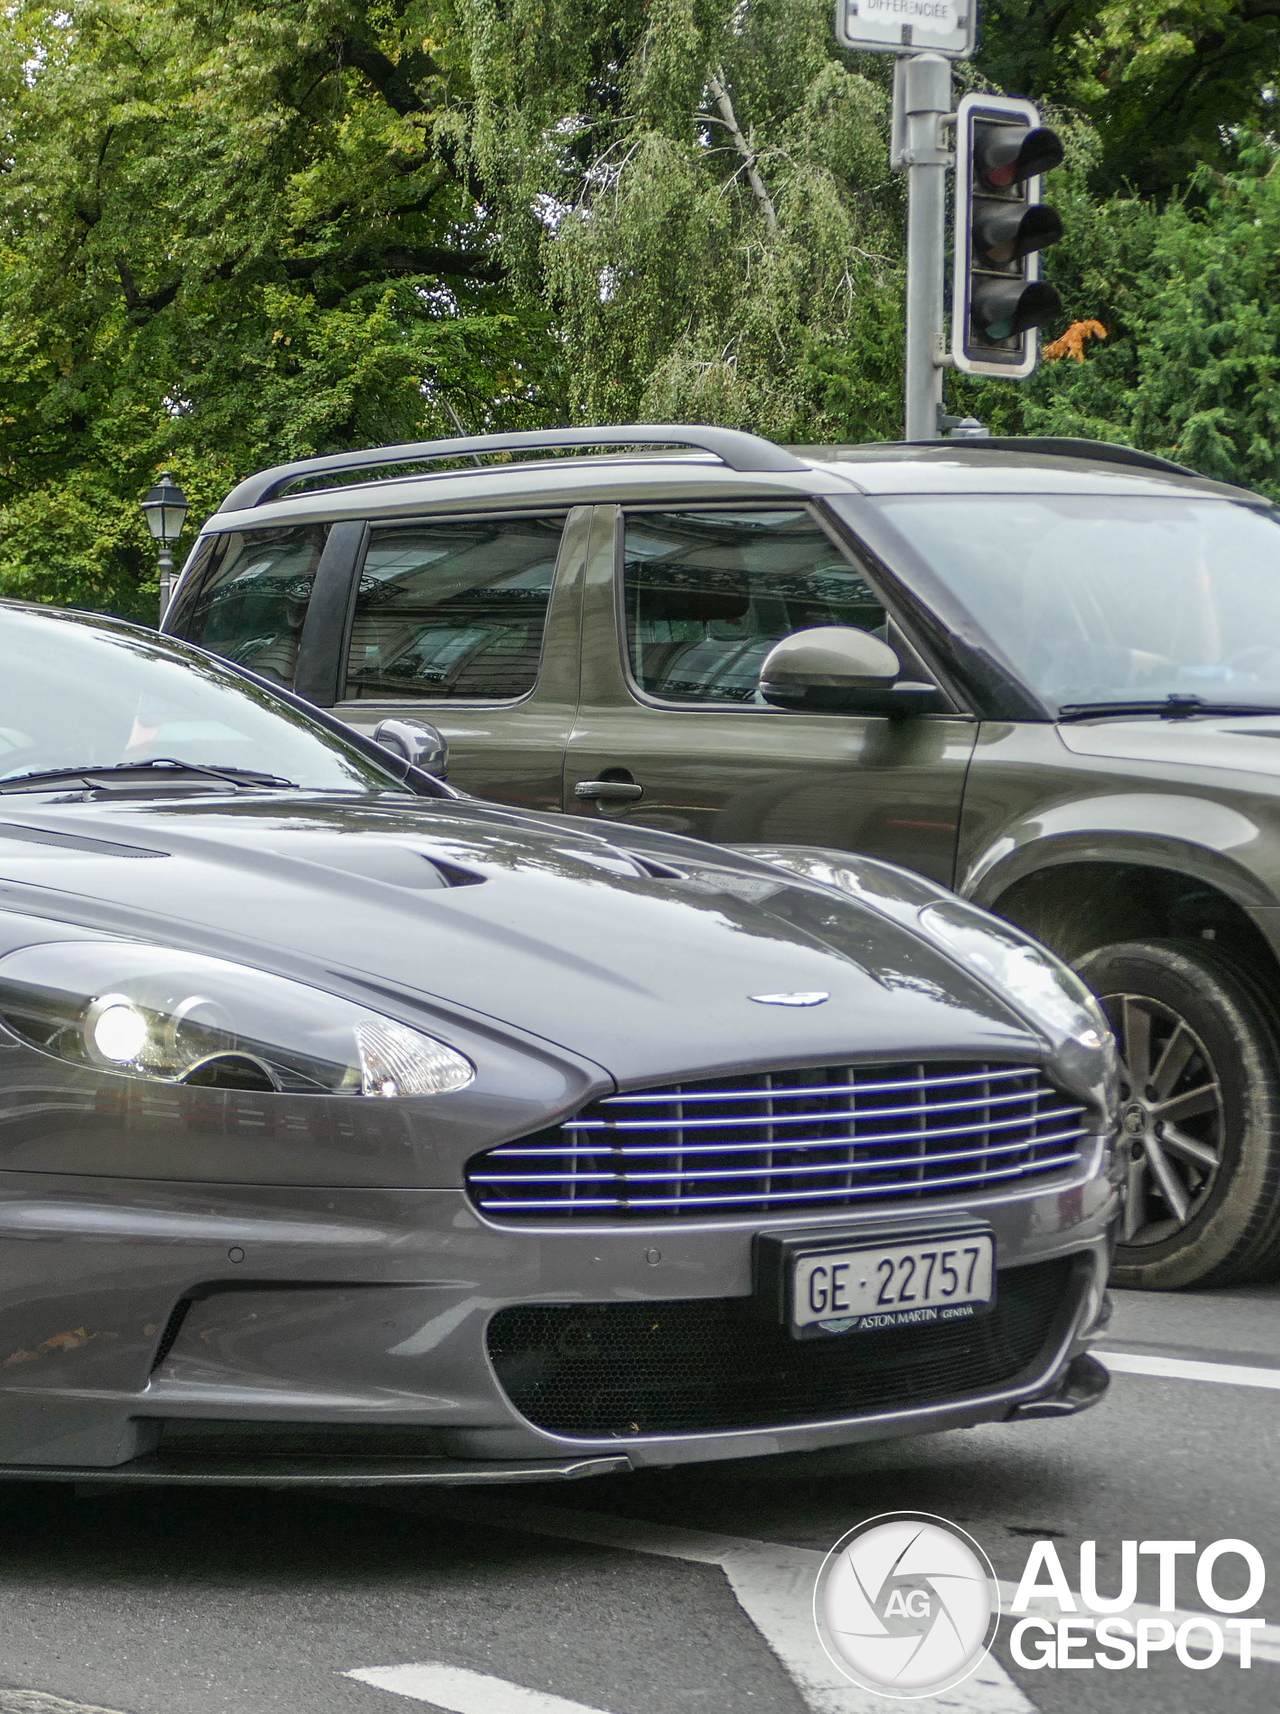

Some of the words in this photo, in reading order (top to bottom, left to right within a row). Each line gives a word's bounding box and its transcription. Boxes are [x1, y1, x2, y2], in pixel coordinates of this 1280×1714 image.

[860, 1314, 896, 1329] ASTON
[898, 1308, 937, 1324] MARTIN
[942, 1307, 974, 1319] GENEVA
